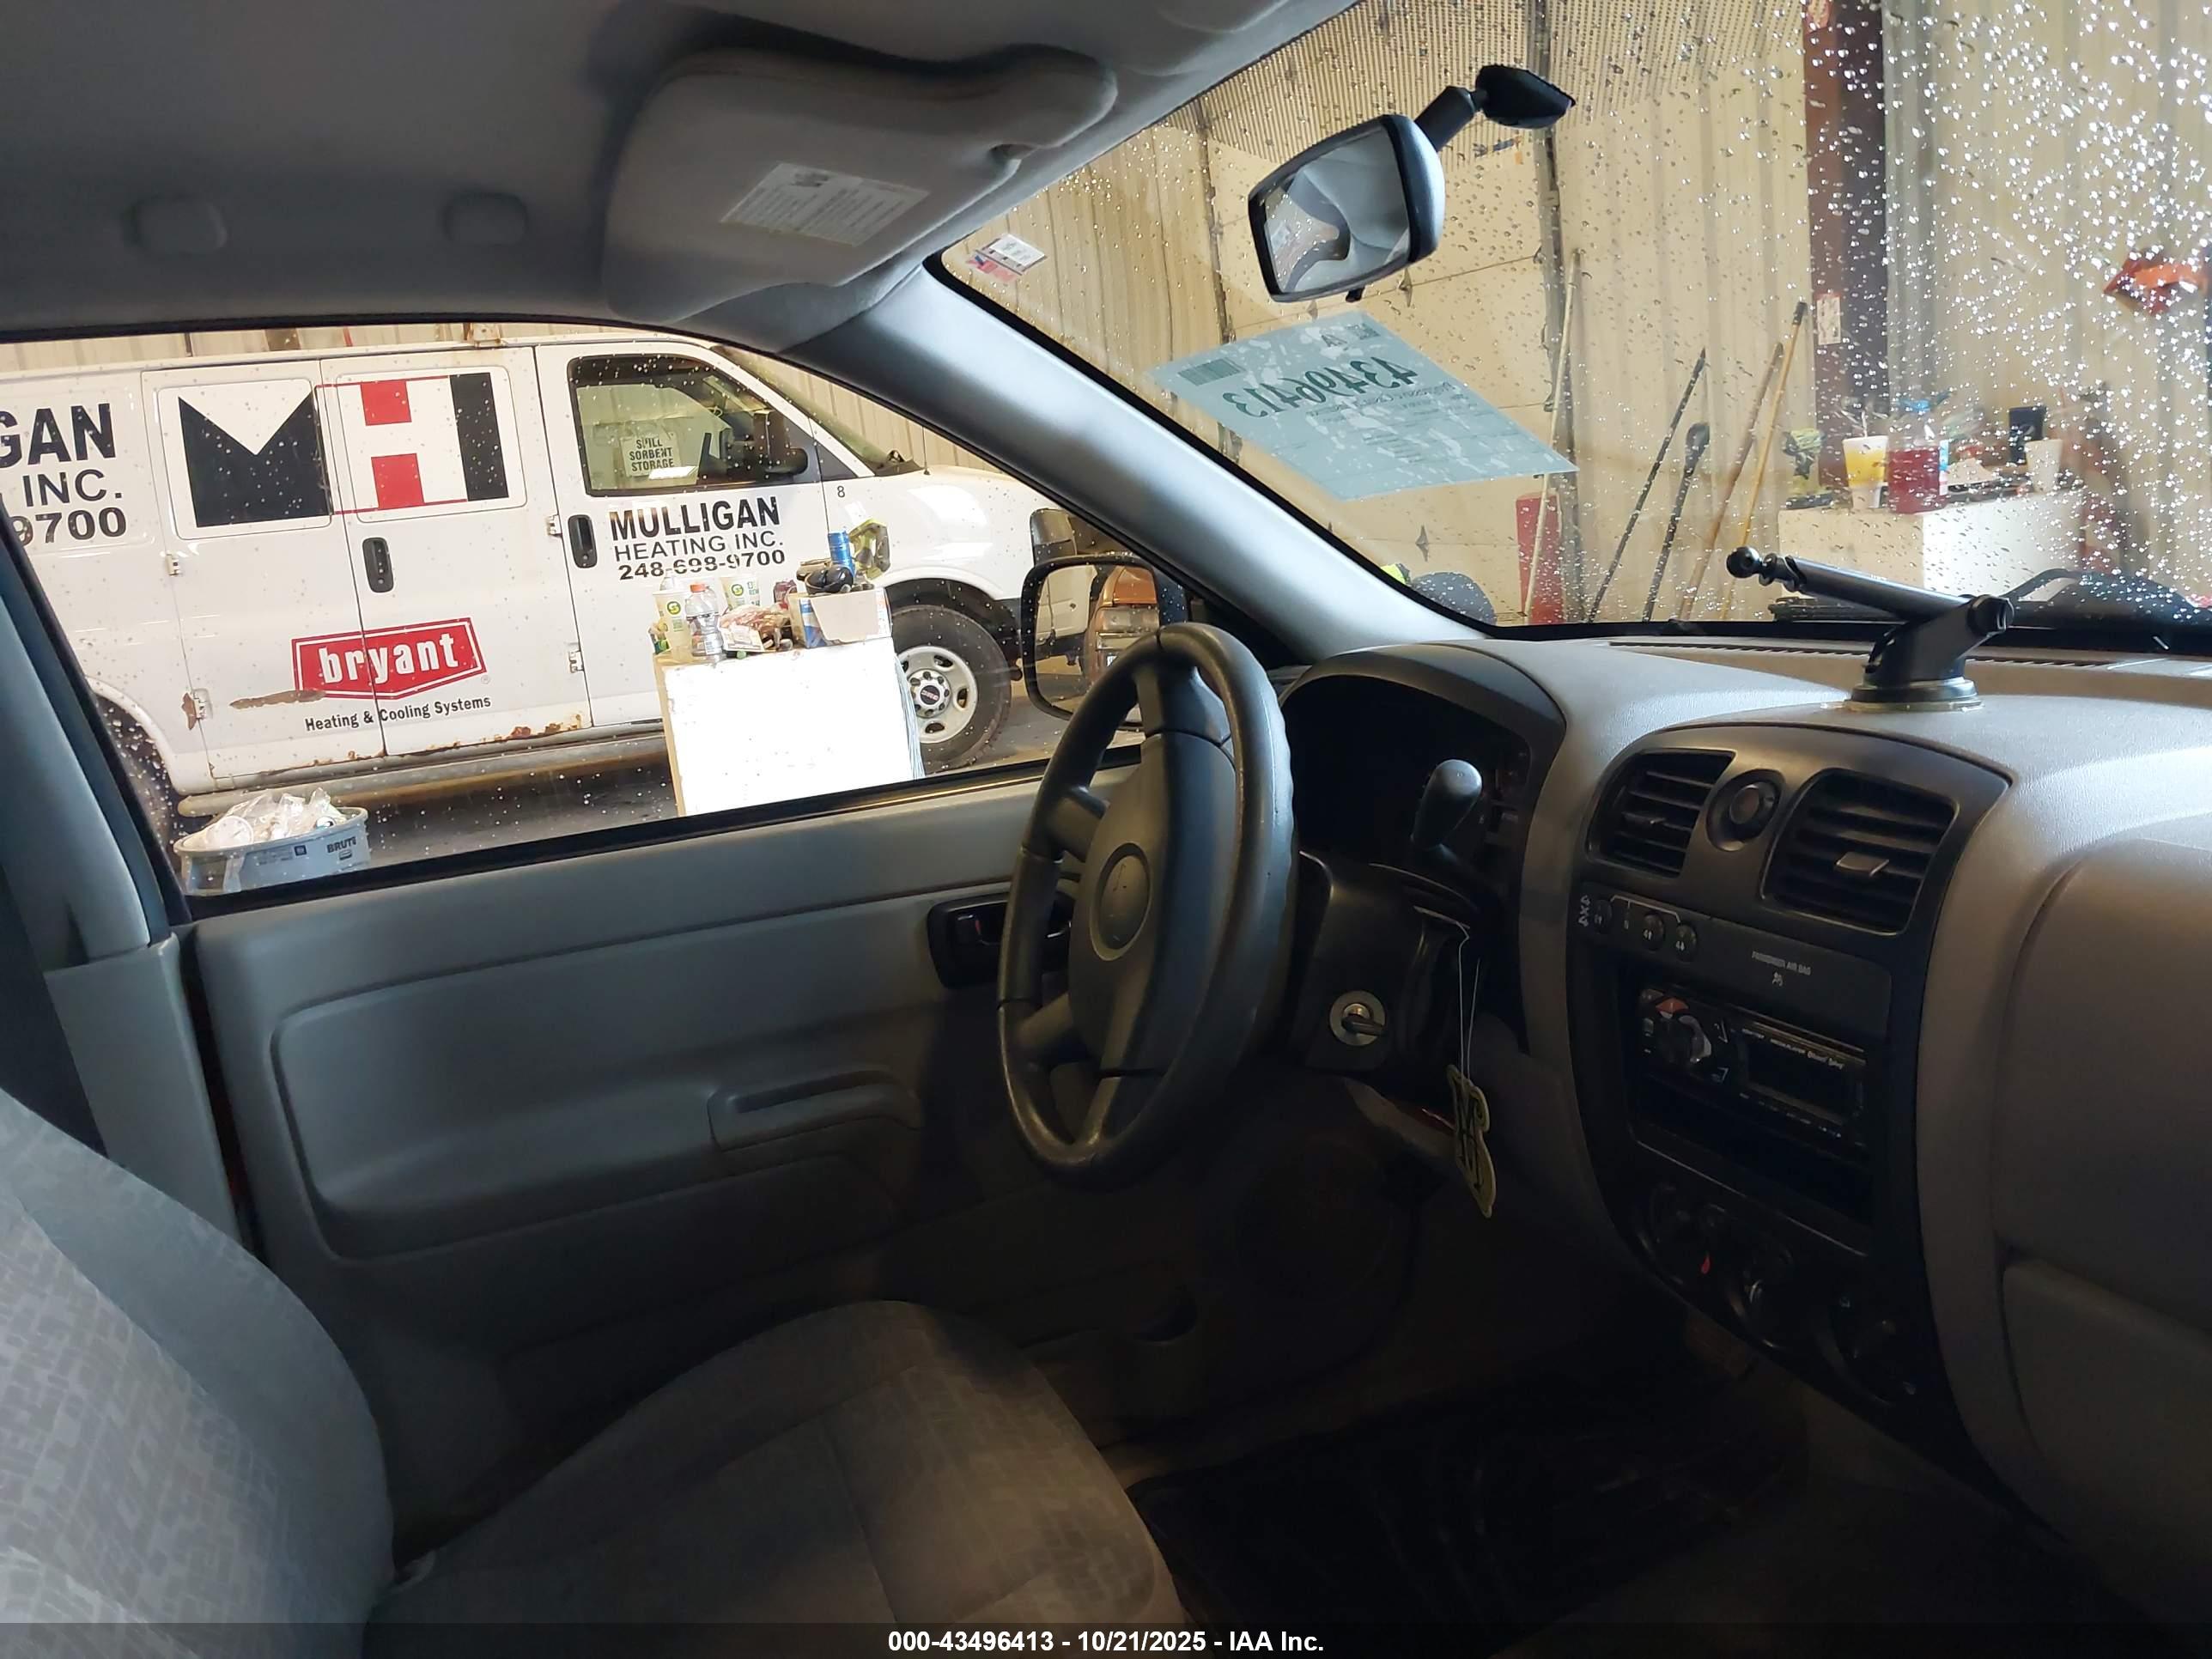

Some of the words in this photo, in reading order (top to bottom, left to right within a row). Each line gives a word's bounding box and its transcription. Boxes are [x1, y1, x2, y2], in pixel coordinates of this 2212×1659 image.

[629, 447, 672, 461] SORBENT
[631, 458, 675, 471] STORAGE
[22, 469, 122, 507] INC.
[837, 485, 845, 498] 8
[609, 495, 780, 541] MULLIGAN
[614, 535, 726, 562] HEATING
[735, 530, 784, 550] INC.
[617, 549, 786, 580] 248-698-9700
[318, 633, 459, 684] bryant
[304, 713, 359, 732] Heating
[363, 710, 374, 724] &
[380, 702, 429, 722] Cooling
[434, 696, 491, 716] Systems
